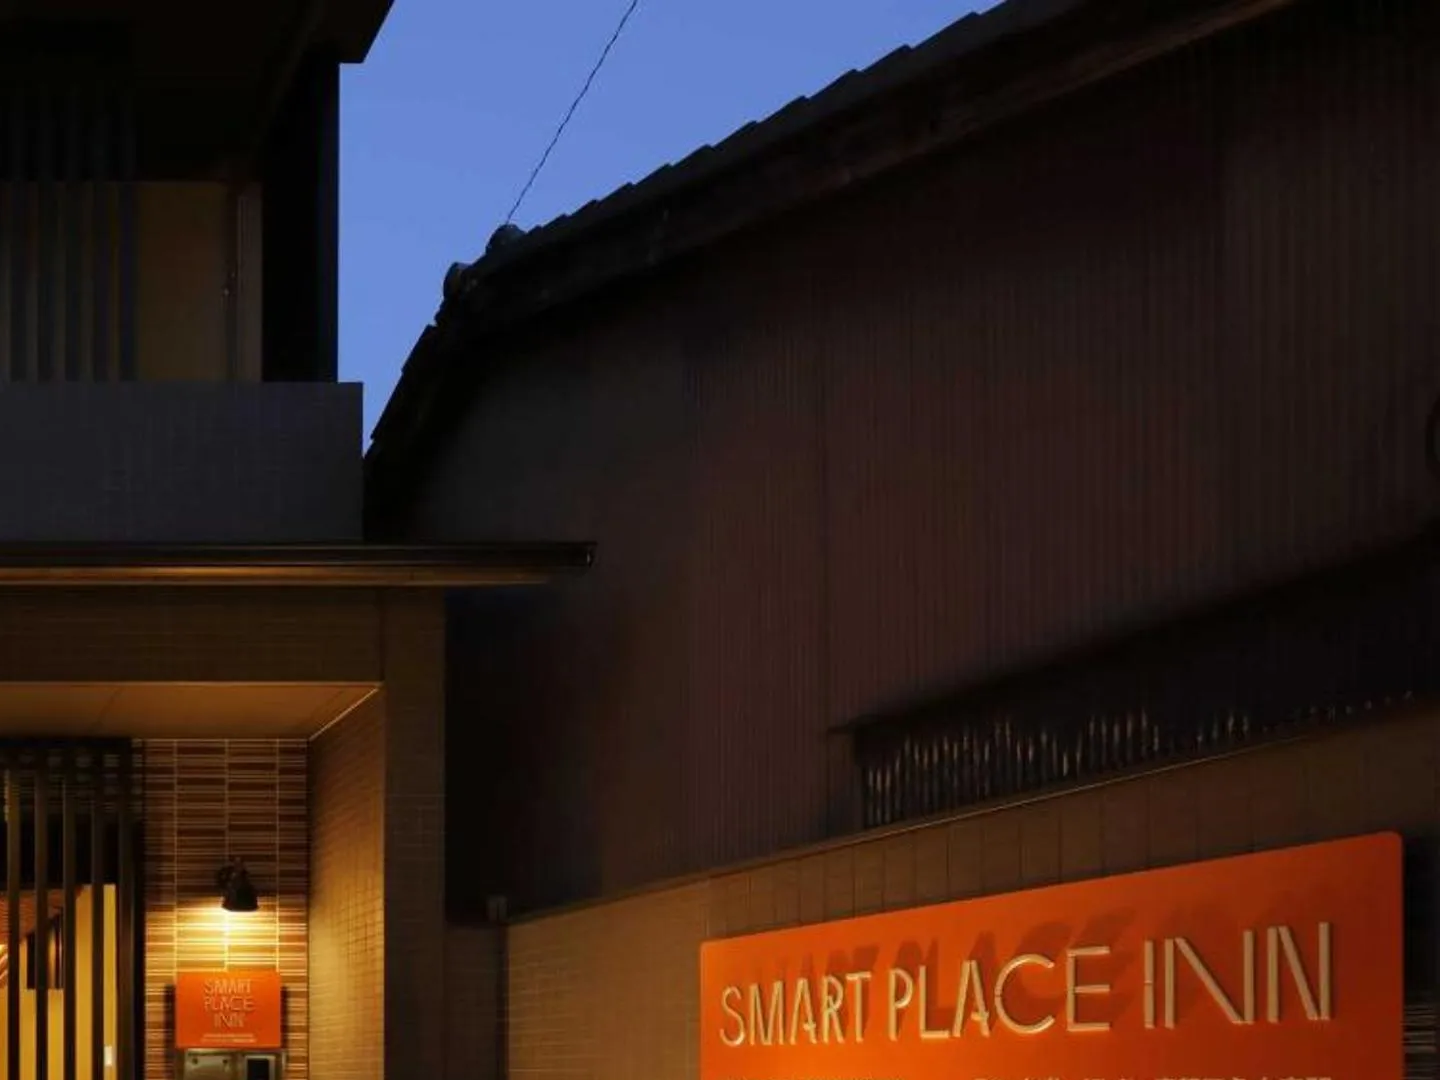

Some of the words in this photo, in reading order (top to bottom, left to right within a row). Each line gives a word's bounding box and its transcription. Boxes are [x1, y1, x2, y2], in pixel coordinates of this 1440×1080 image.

[204, 979, 252, 994] SMART
[719, 971, 871, 1046] SMART
[888, 945, 1110, 1041] PLACE
[1144, 922, 1330, 1029] INN
[205, 996, 254, 1011] PLACE
[215, 1013, 245, 1027] INN
